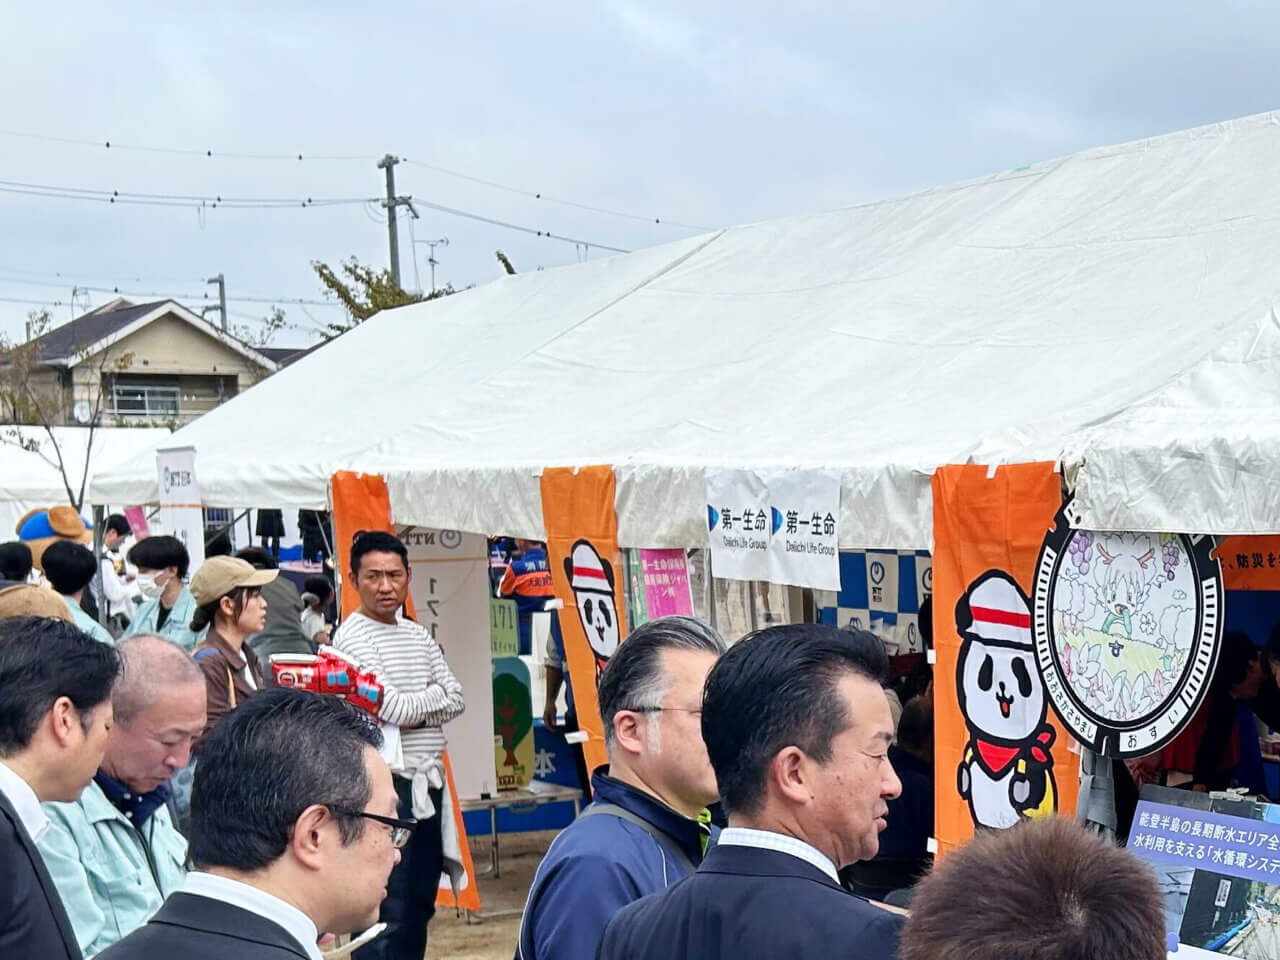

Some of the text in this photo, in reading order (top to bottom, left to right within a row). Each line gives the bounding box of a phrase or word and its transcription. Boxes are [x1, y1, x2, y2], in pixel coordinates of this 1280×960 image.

[721, 508, 767, 531] 第一生命
[786, 510, 836, 536] 第一生命
[749, 538, 767, 551] Group
[818, 544, 836, 556] Group
[1047, 671, 1095, 740] おおさかさやまし
[1128, 710, 1179, 749] おすい
